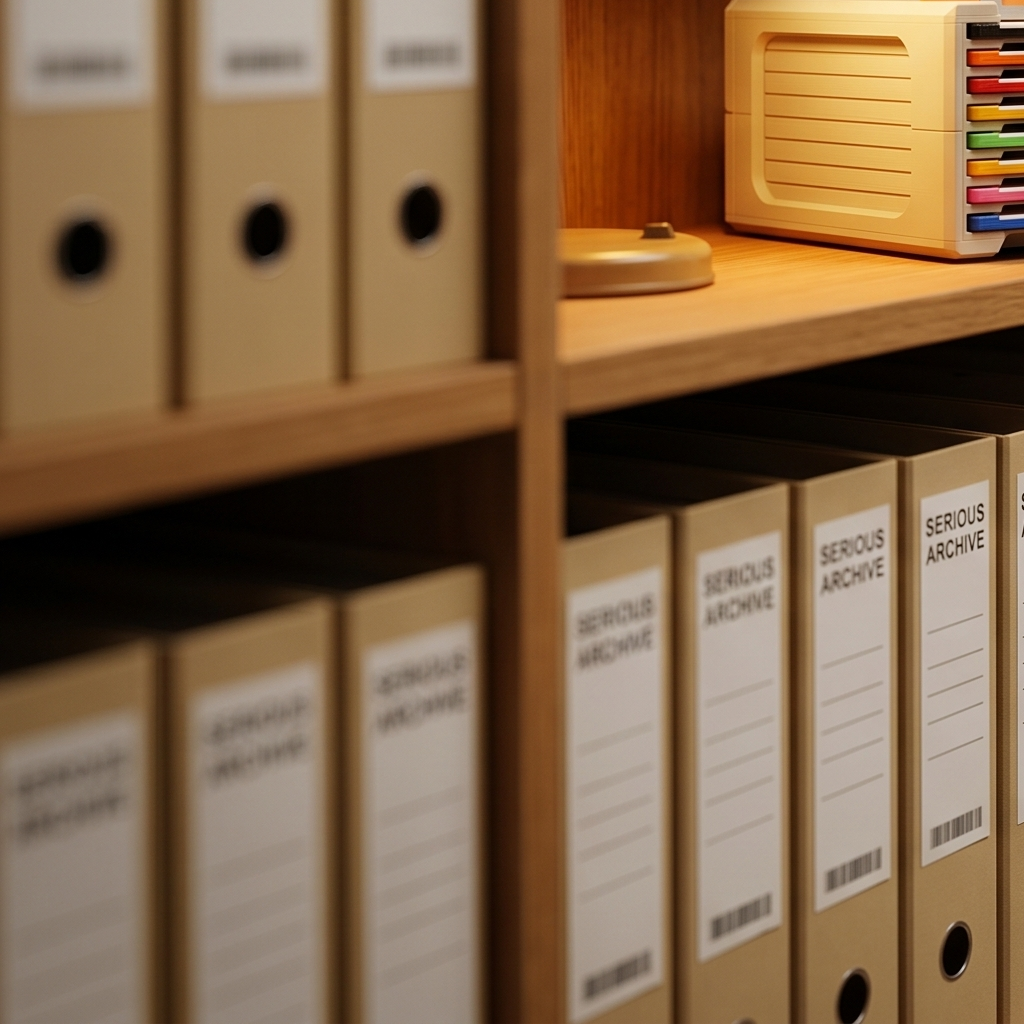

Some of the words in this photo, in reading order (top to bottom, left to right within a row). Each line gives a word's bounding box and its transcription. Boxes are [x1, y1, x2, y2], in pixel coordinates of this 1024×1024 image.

[925, 503, 985, 537] SERIOUS
[820, 528, 885, 567] SERIOUS
[925, 529, 985, 566] ARCHIVE
[703, 555, 775, 599] SERIOUS
[820, 556, 885, 596] ARCHIVE
[703, 586, 774, 629] ARCHIVE
